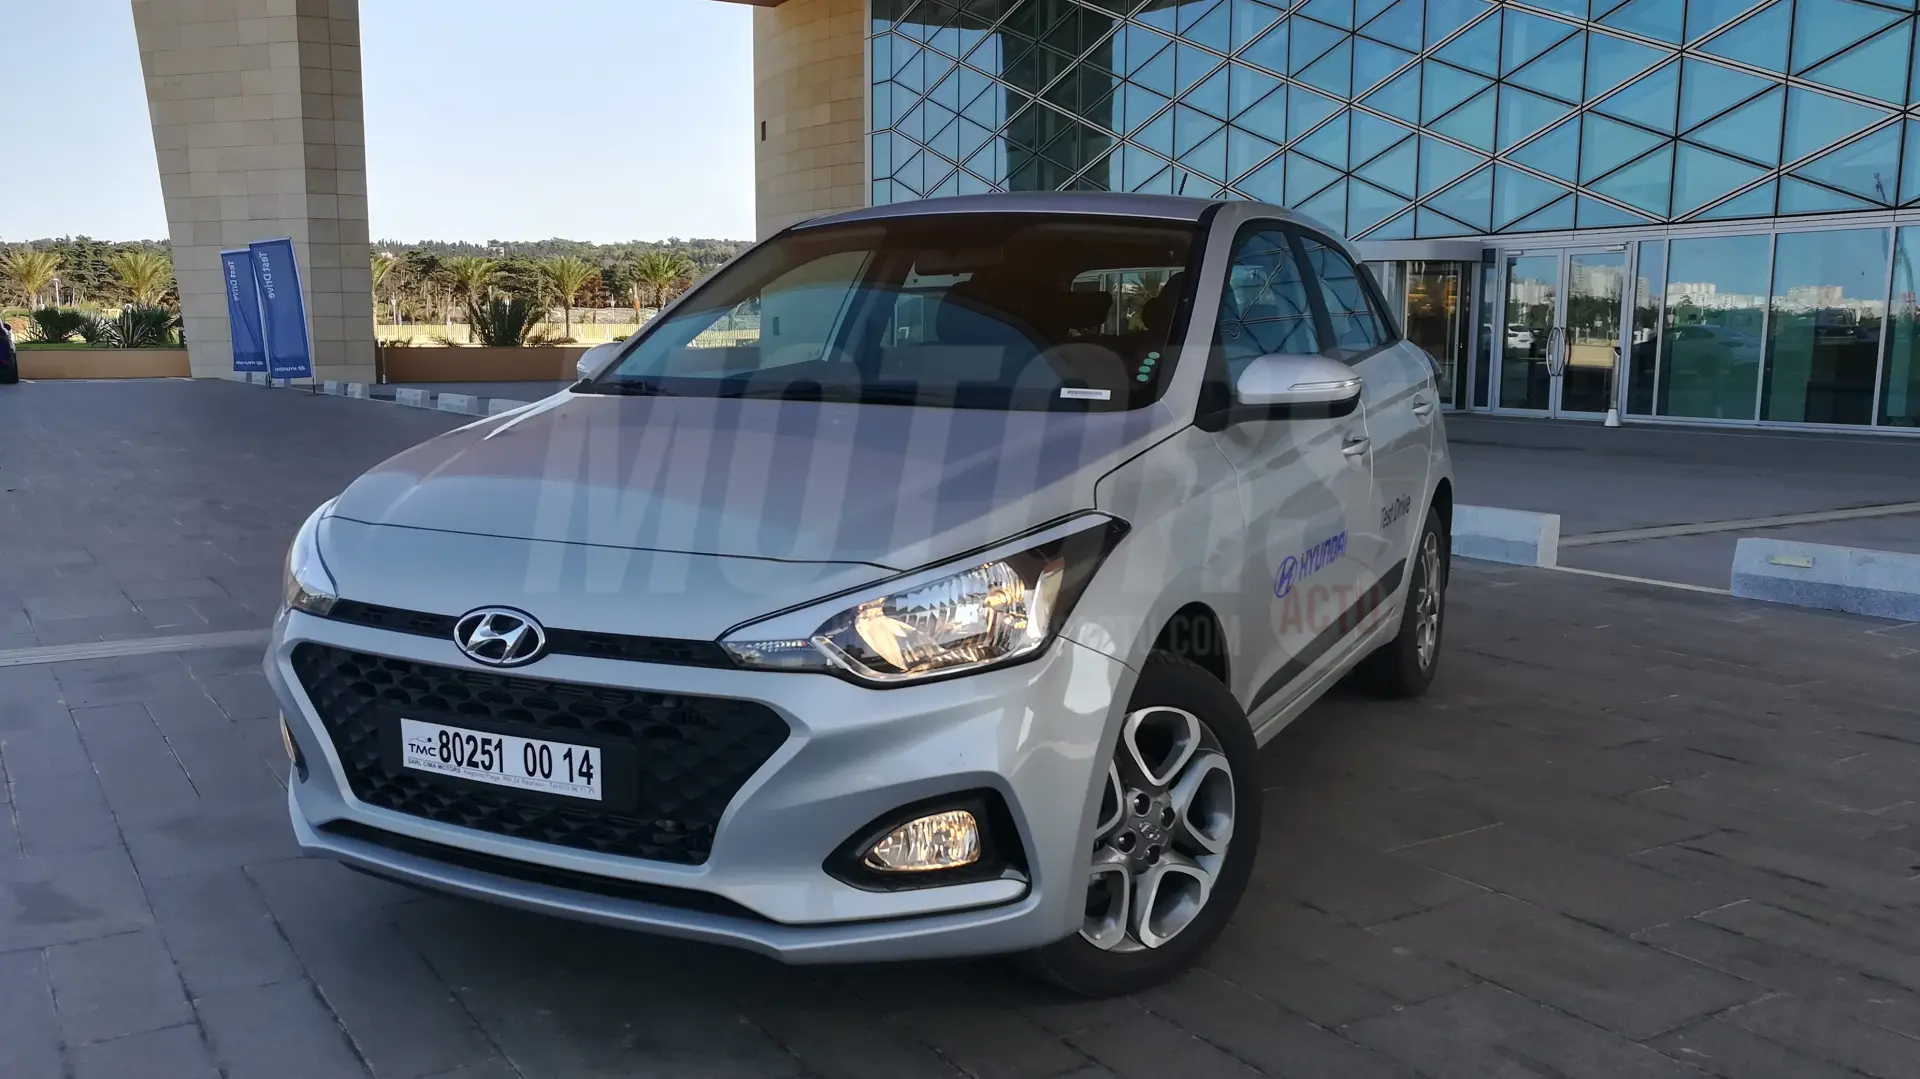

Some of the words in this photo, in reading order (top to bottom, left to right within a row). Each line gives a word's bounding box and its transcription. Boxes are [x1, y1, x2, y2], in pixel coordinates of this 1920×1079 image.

[1380, 506, 1395, 531] Test
[1393, 493, 1411, 522] Drive
[1298, 529, 1349, 582] HYUNDAI
[408, 743, 437, 757] TMC
[438, 729, 505, 773] 80251
[523, 741, 553, 780] 00
[562, 747, 594, 786] 14
